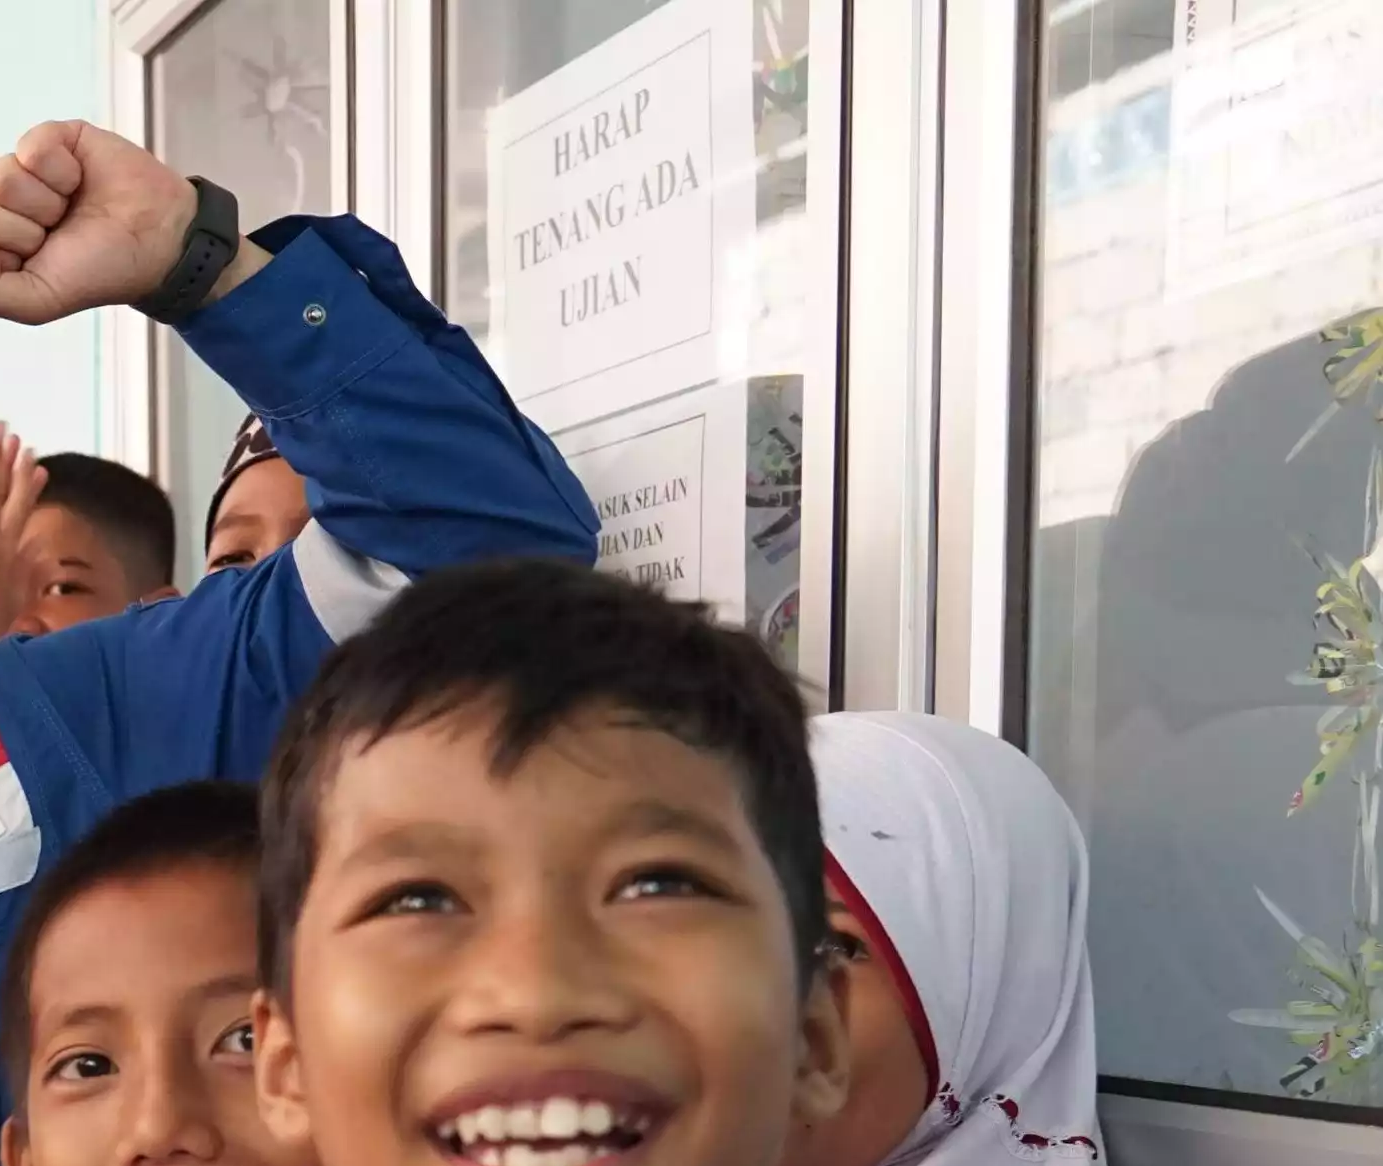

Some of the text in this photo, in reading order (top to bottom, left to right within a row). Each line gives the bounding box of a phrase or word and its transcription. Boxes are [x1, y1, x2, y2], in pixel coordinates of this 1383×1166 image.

[554, 88, 650, 178] HARAP
[514, 147, 699, 271] TENANG ADA
[560, 254, 642, 327] UJIAN
[598, 476, 689, 520] ASUK SELAIN
[600, 522, 664, 558] JIAN DAN
[636, 556, 685, 586] TIDAK
